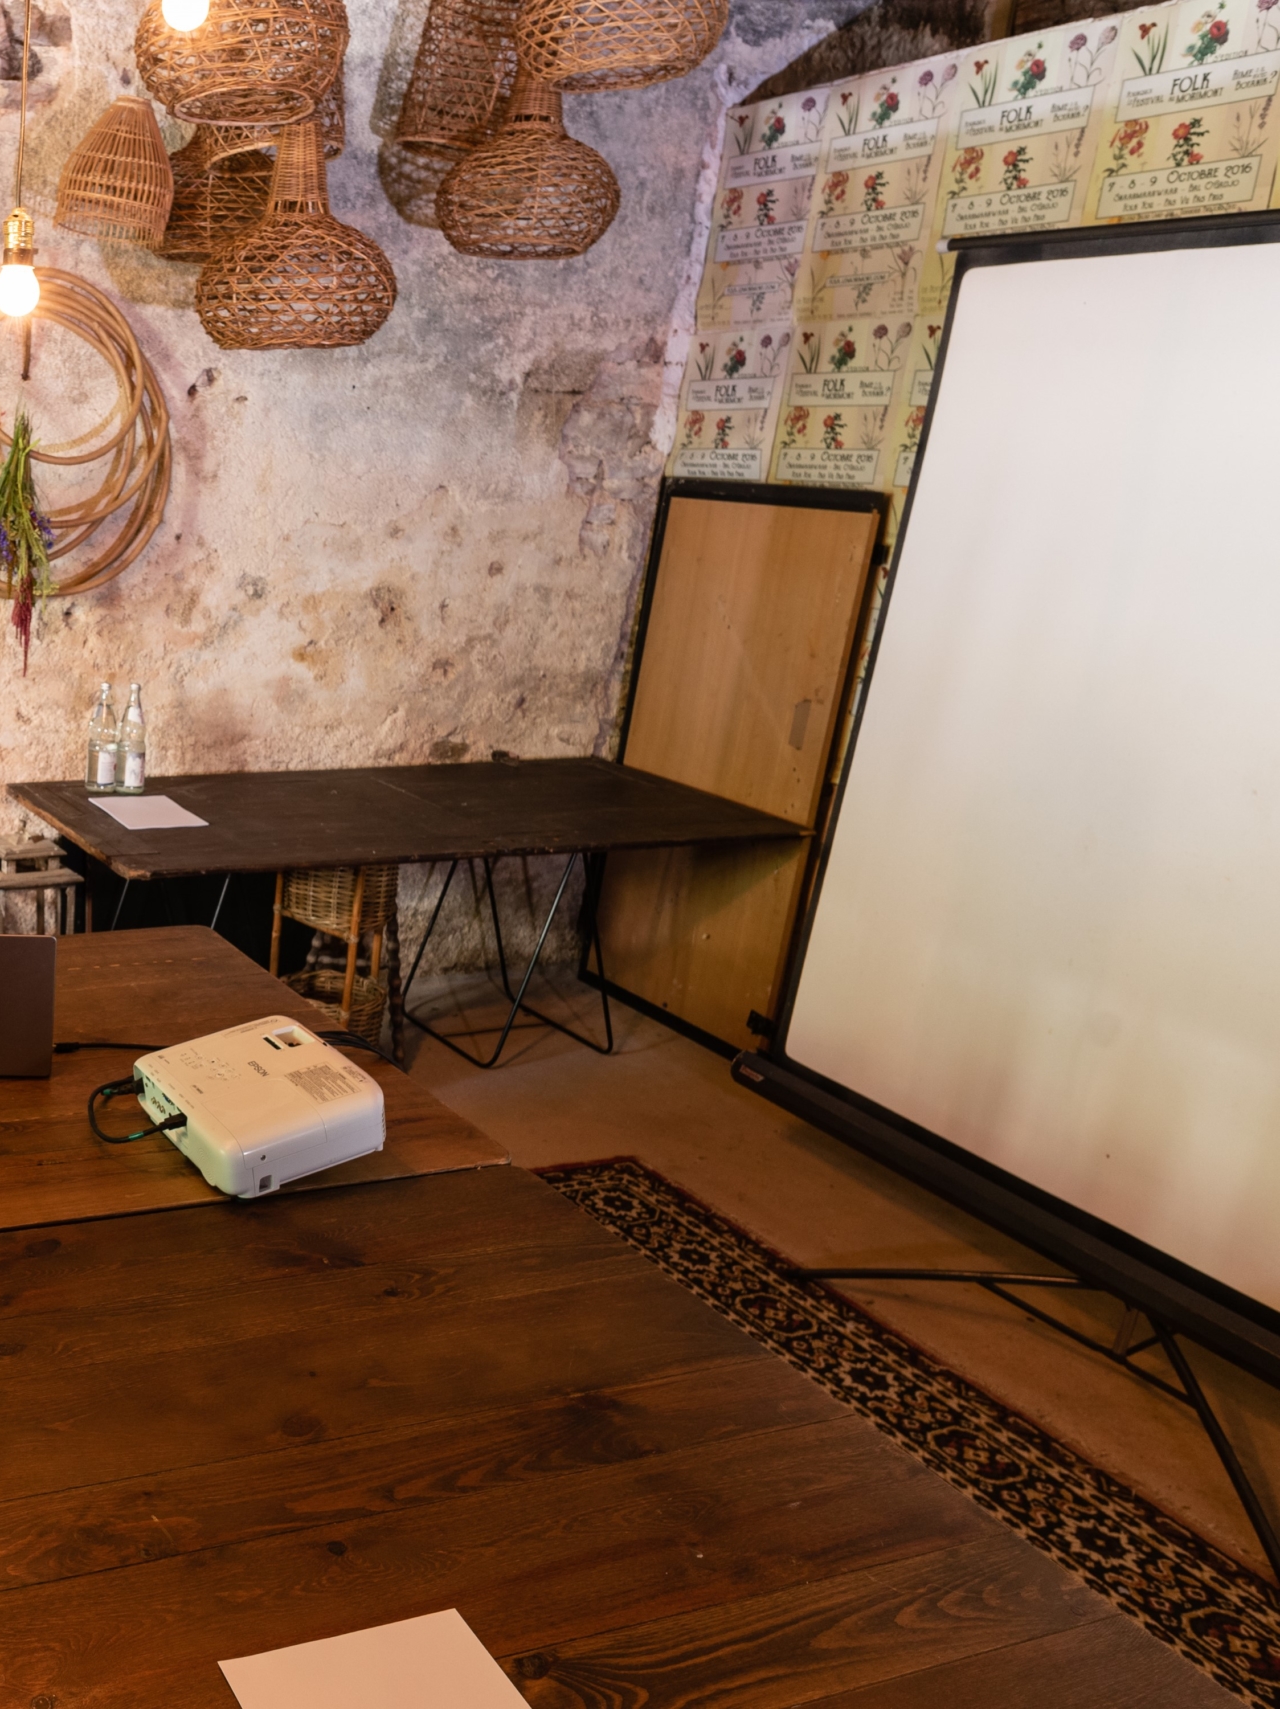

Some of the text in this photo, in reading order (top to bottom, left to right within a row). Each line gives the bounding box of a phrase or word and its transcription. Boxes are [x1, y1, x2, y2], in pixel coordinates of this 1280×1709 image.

[1171, 72, 1211, 95] FOLK
[1175, 87, 1224, 104] MORIMONT
[1000, 105, 1033, 126] FOLK
[862, 134, 888, 151] FOLK
[753, 155, 777, 172] FOLK
[1167, 168, 1220, 184] OCTOBRE
[1224, 163, 1253, 179] 2016
[999, 193, 1042, 206] OCTOBRE
[1046, 188, 1069, 202] 2016
[714, 384, 737, 397] FOLK
[822, 378, 846, 392] FOLK
[248, 1060, 269, 1078] EPSON
